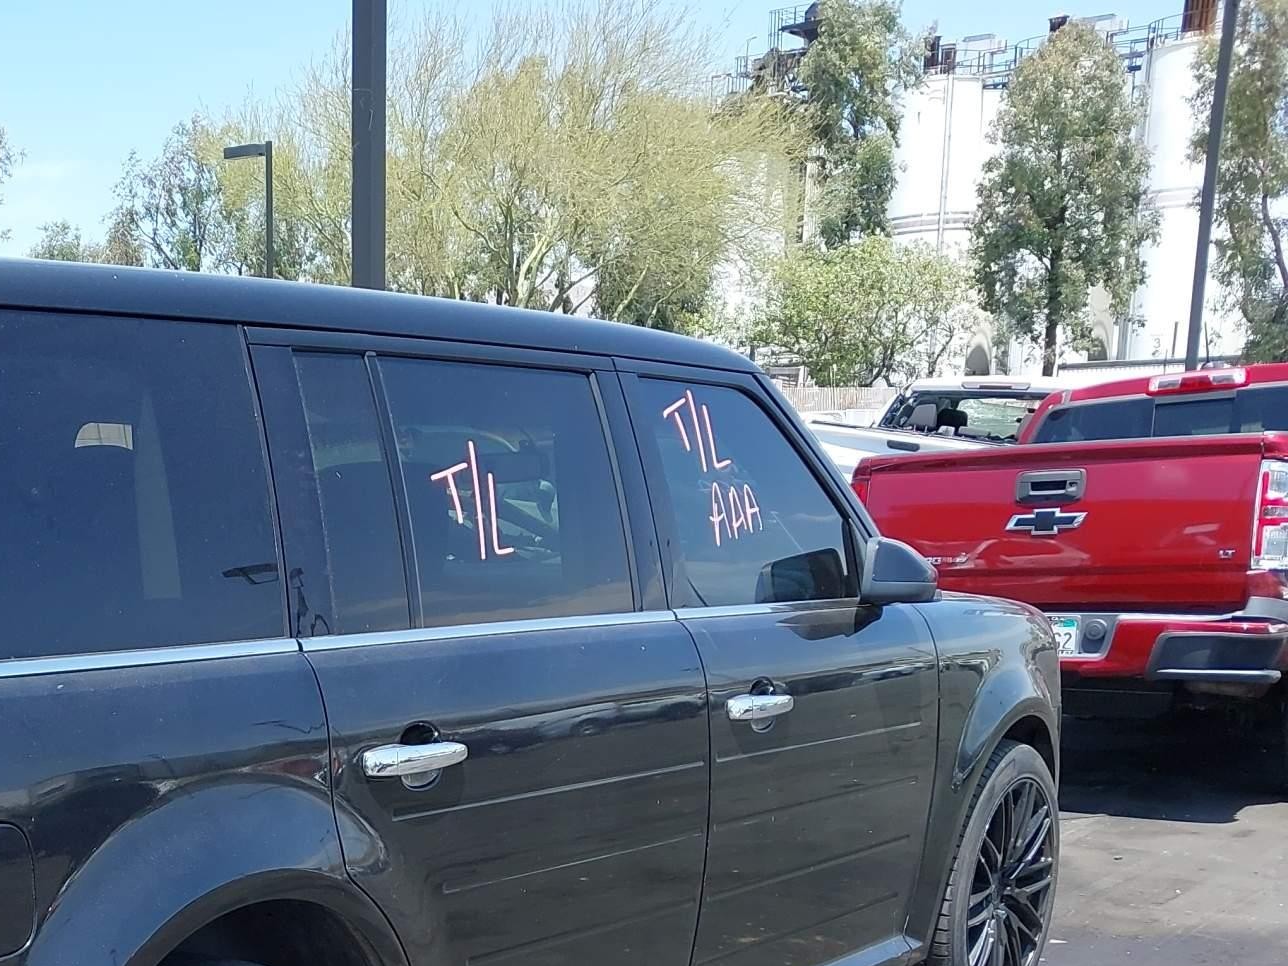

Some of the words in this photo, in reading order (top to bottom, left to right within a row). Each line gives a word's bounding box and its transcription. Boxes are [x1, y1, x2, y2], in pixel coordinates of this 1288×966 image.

[663, 389, 732, 473] T/L
[431, 441, 515, 560] T/L
[1219, 549, 1236, 559] LT
